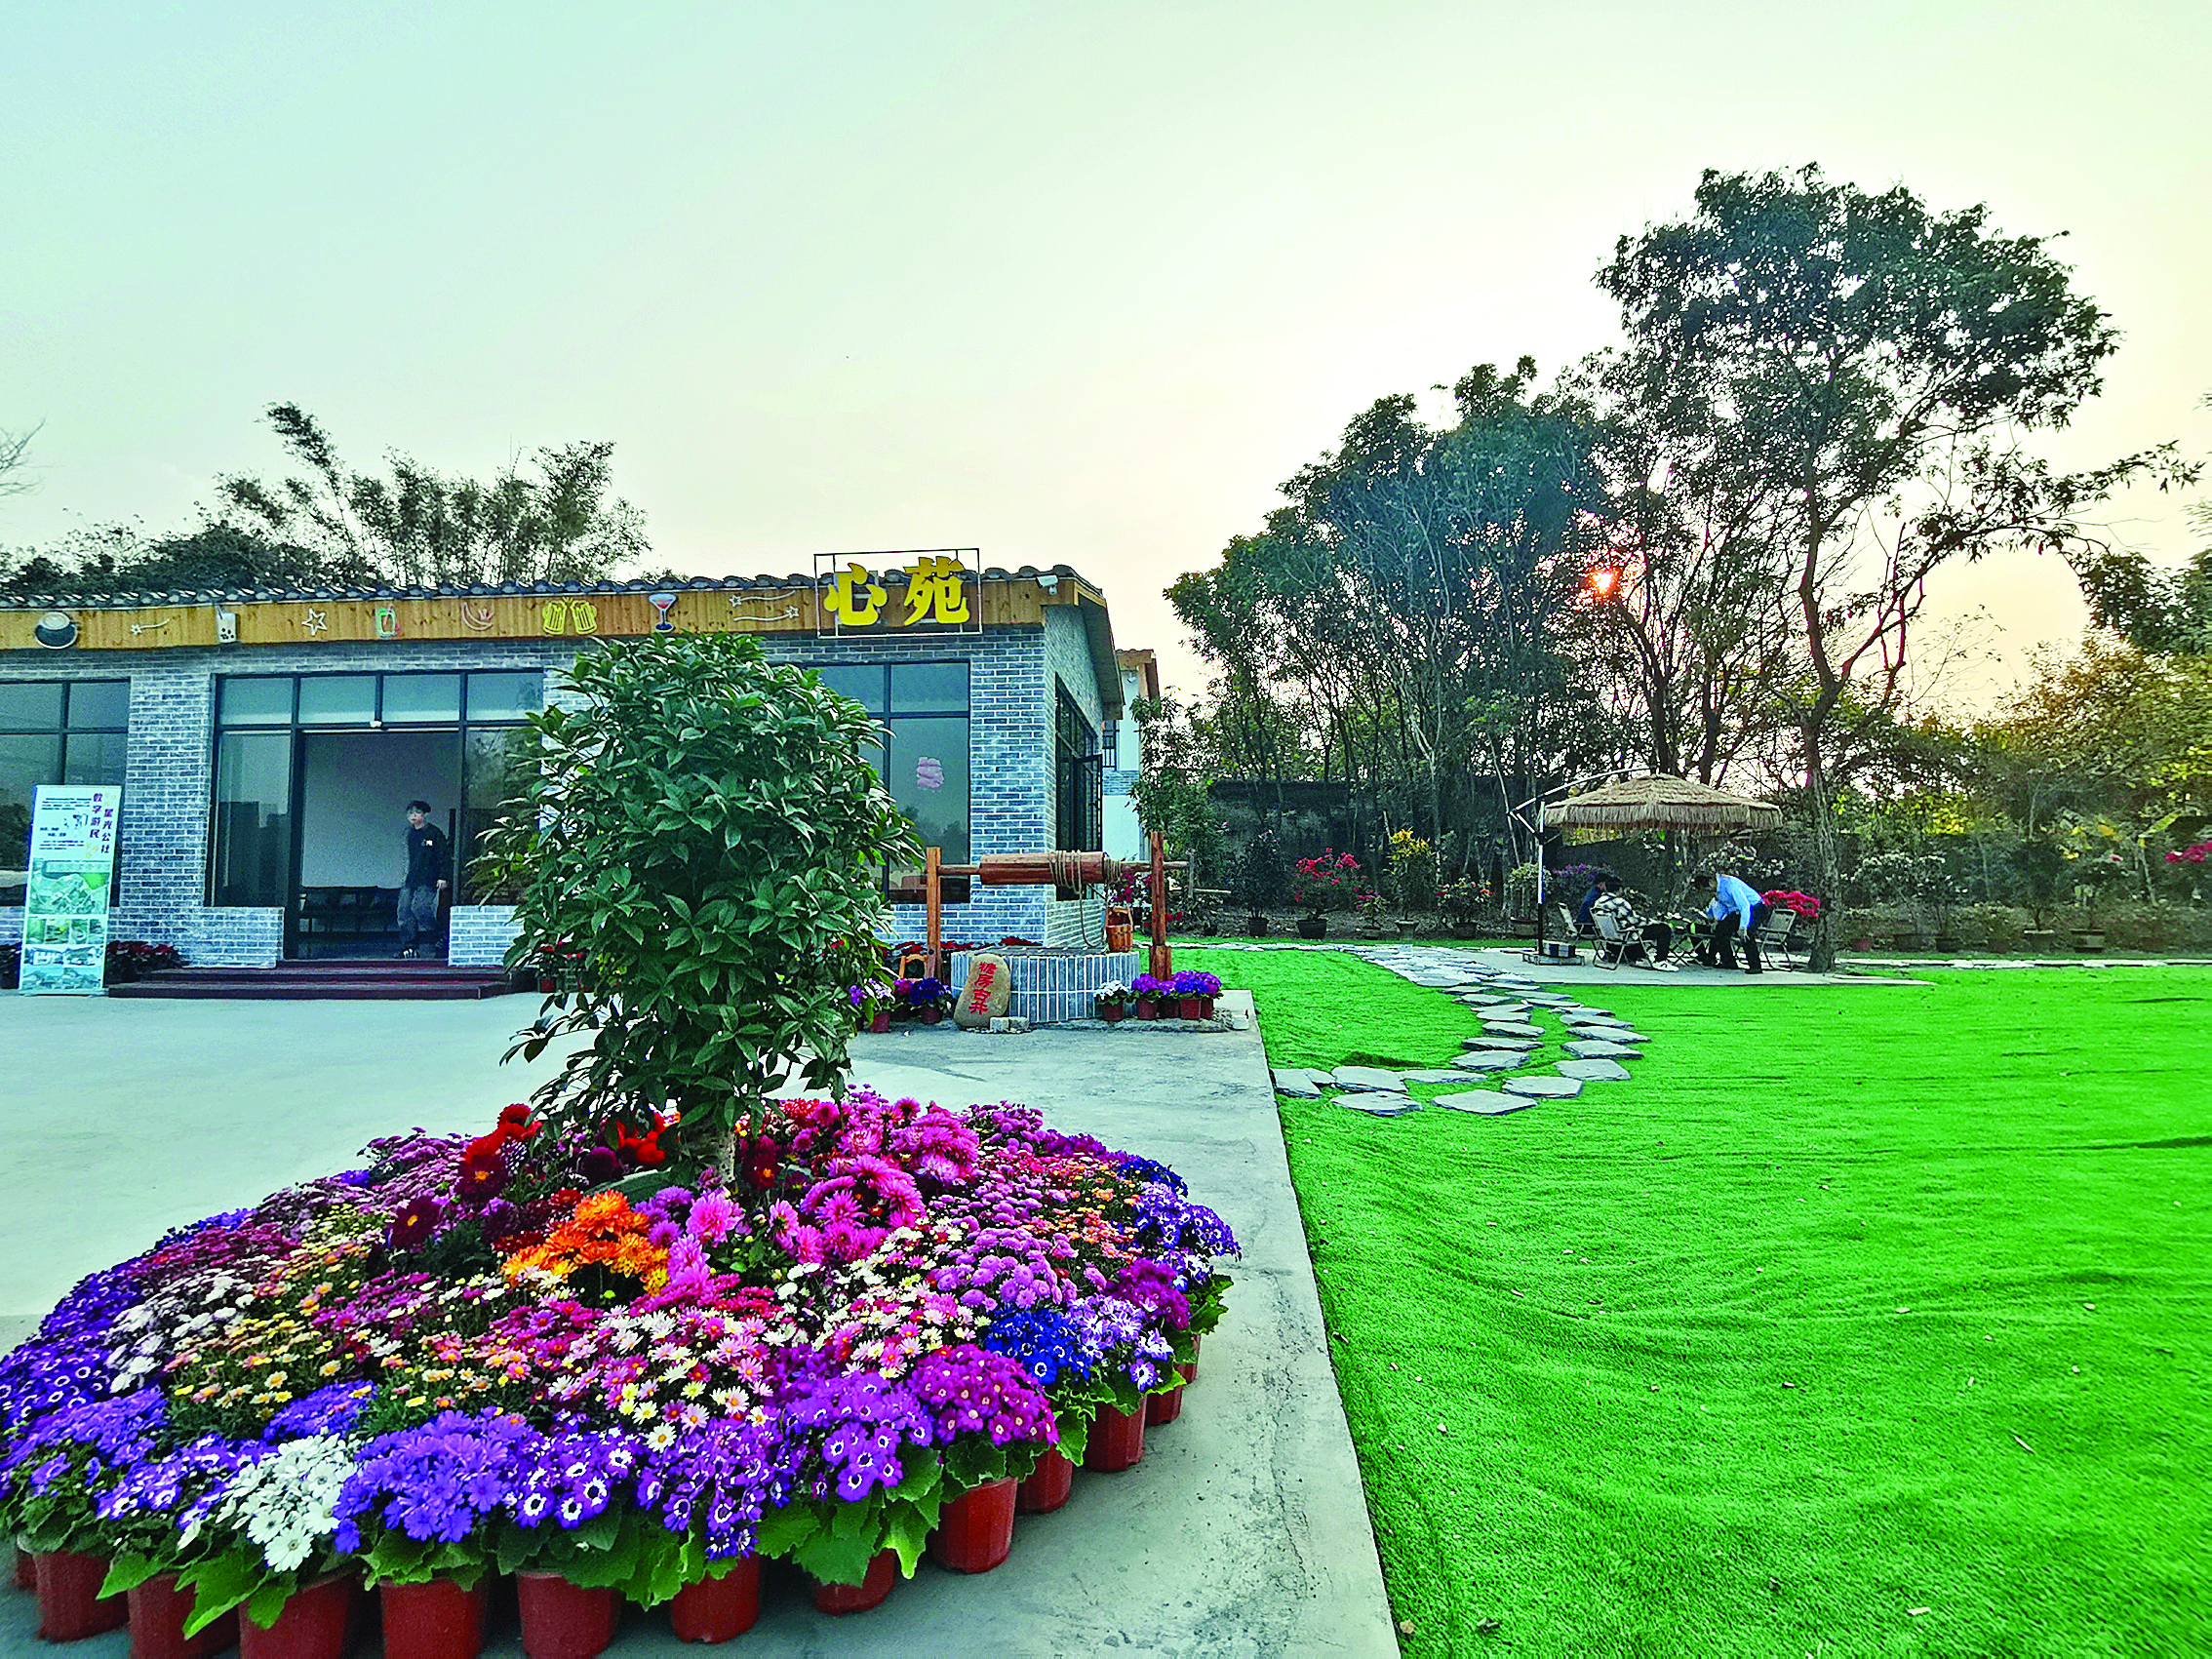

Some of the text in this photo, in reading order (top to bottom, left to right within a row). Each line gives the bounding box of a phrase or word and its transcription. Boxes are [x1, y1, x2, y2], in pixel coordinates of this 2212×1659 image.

[824, 556, 969, 626] 心苑
[90, 793, 102, 838] 数字游民
